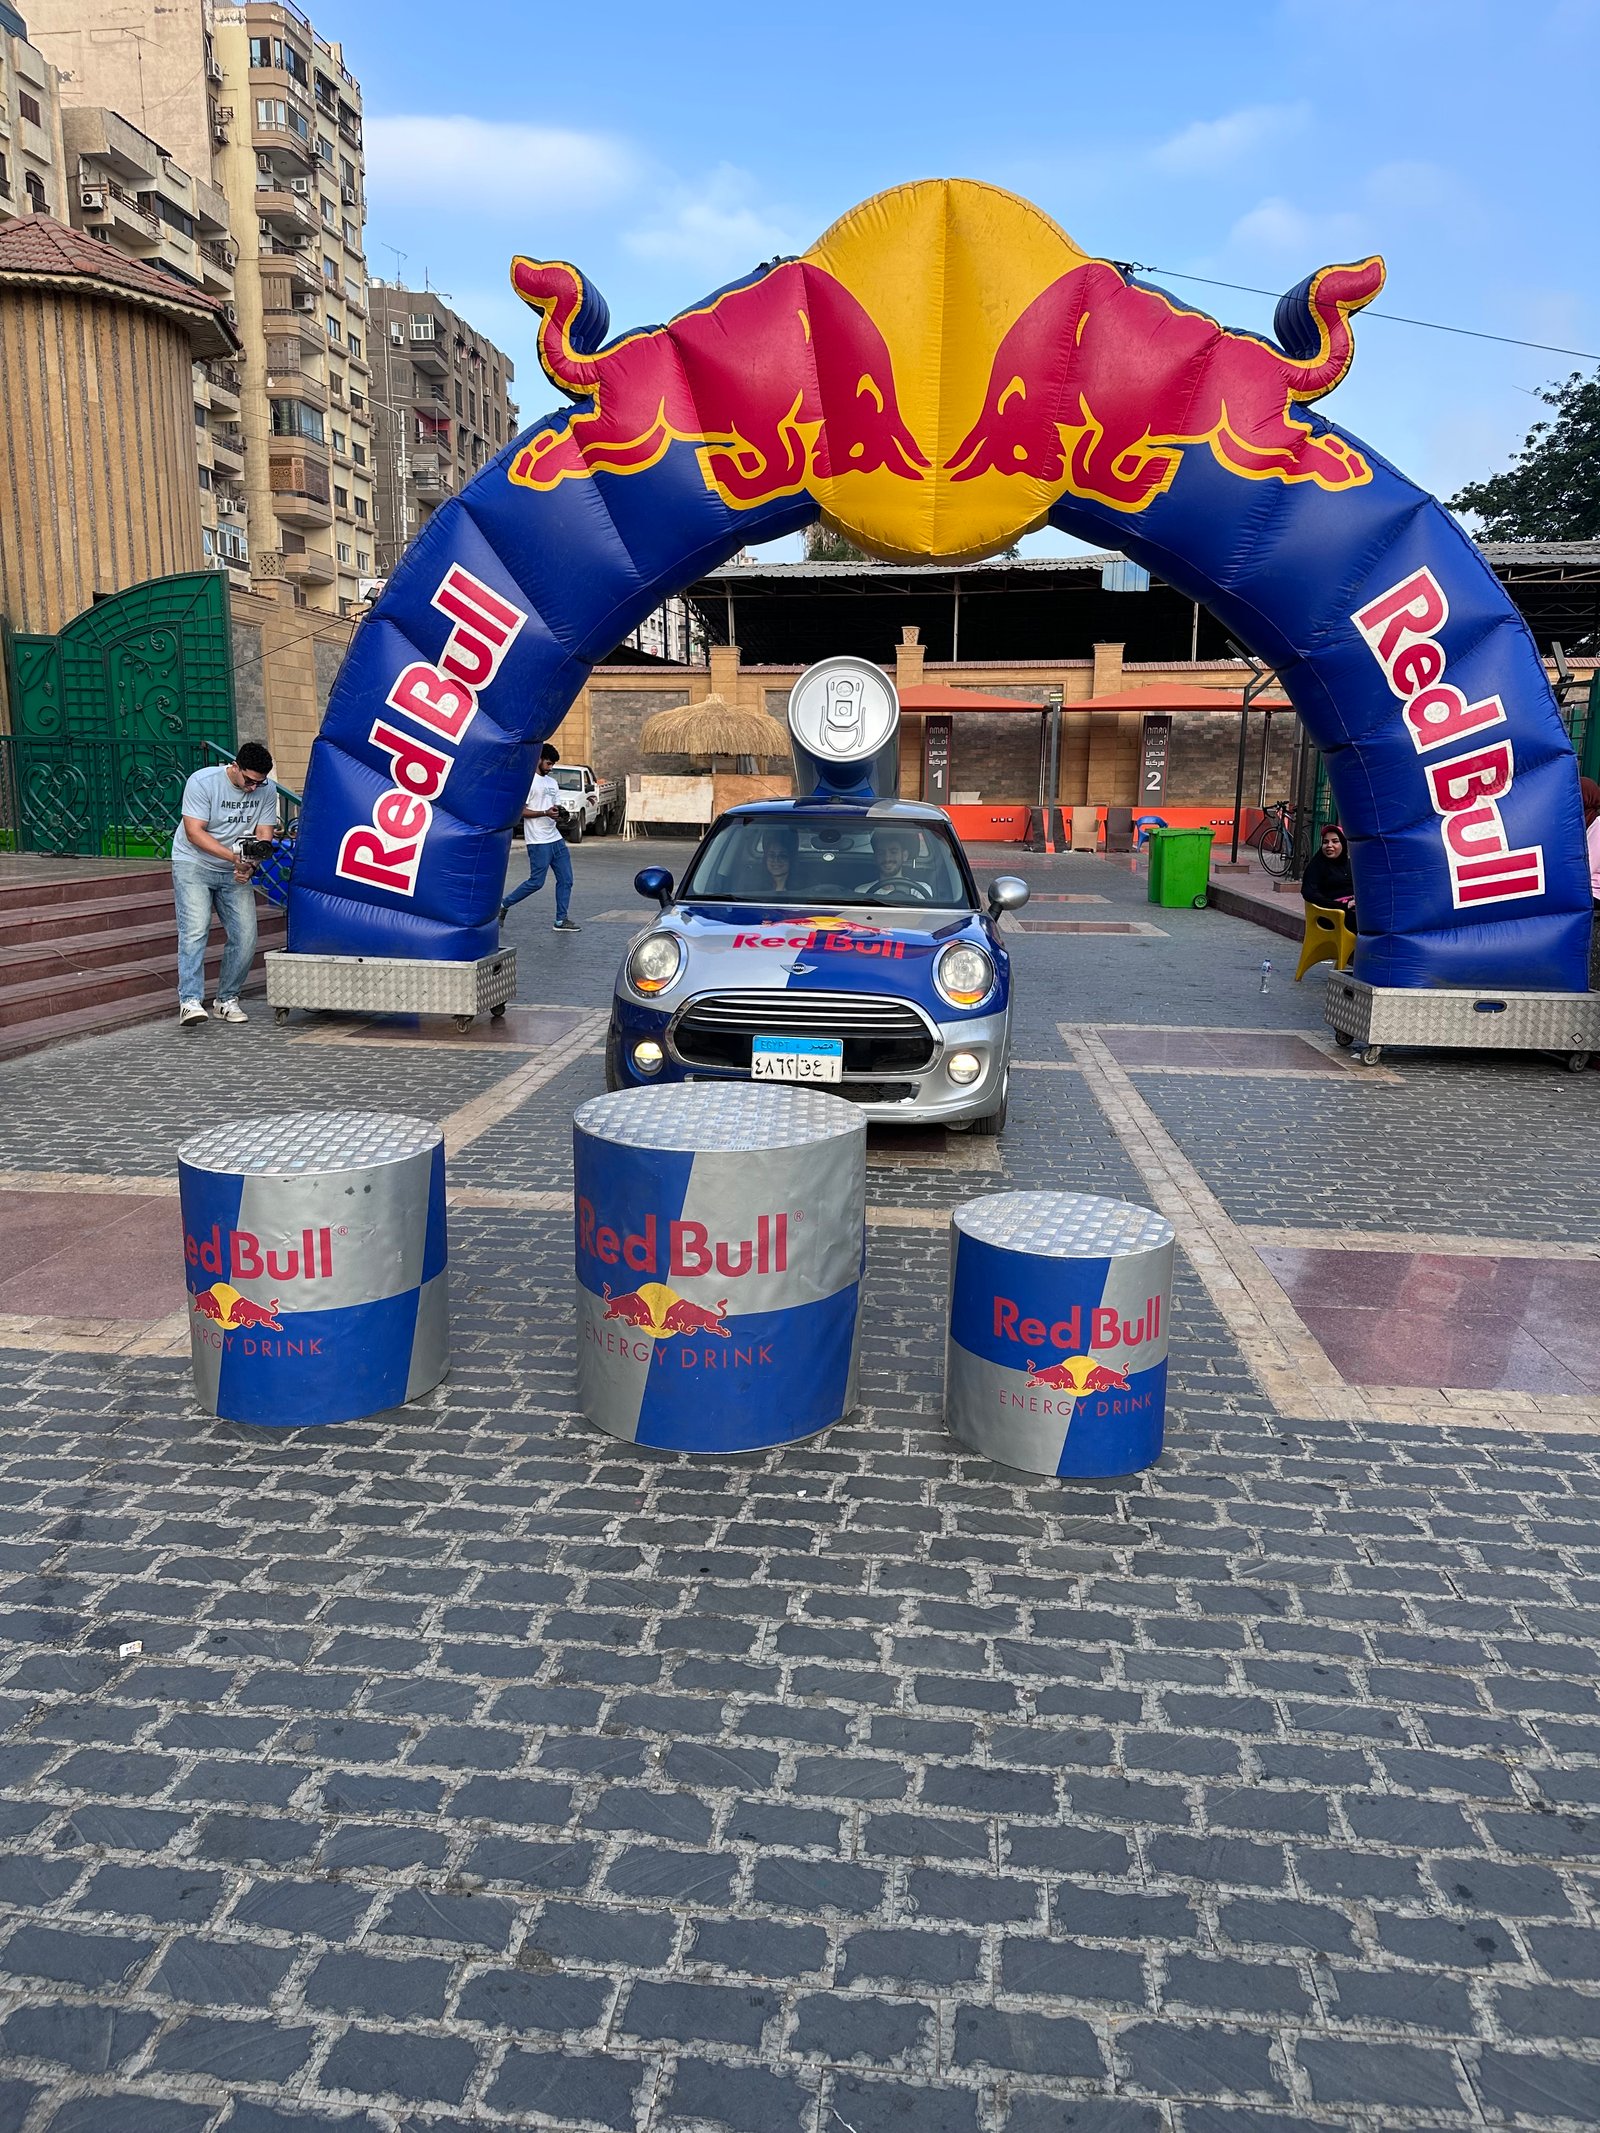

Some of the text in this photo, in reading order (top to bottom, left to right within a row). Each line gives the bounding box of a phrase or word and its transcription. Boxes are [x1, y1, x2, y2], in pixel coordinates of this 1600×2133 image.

[339, 566, 524, 894] Red Bull
[1354, 569, 1542, 906] Red Bull
[932, 769, 943, 789] 1
[1145, 771, 1162, 791] 2
[732, 931, 905, 960] Red Bull
[760, 1040, 790, 1050] EGYPT
[807, 1042, 834, 1051] مصر
[182, 1217, 334, 1281] ed Bull
[578, 1195, 789, 1278] Red Bull
[993, 1294, 1161, 1350] Red Bull
[243, 1338, 324, 1358] DRINK
[585, 1320, 775, 1369] ENERGY DRINK
[1000, 1389, 1153, 1417] ENERGY DRINK
